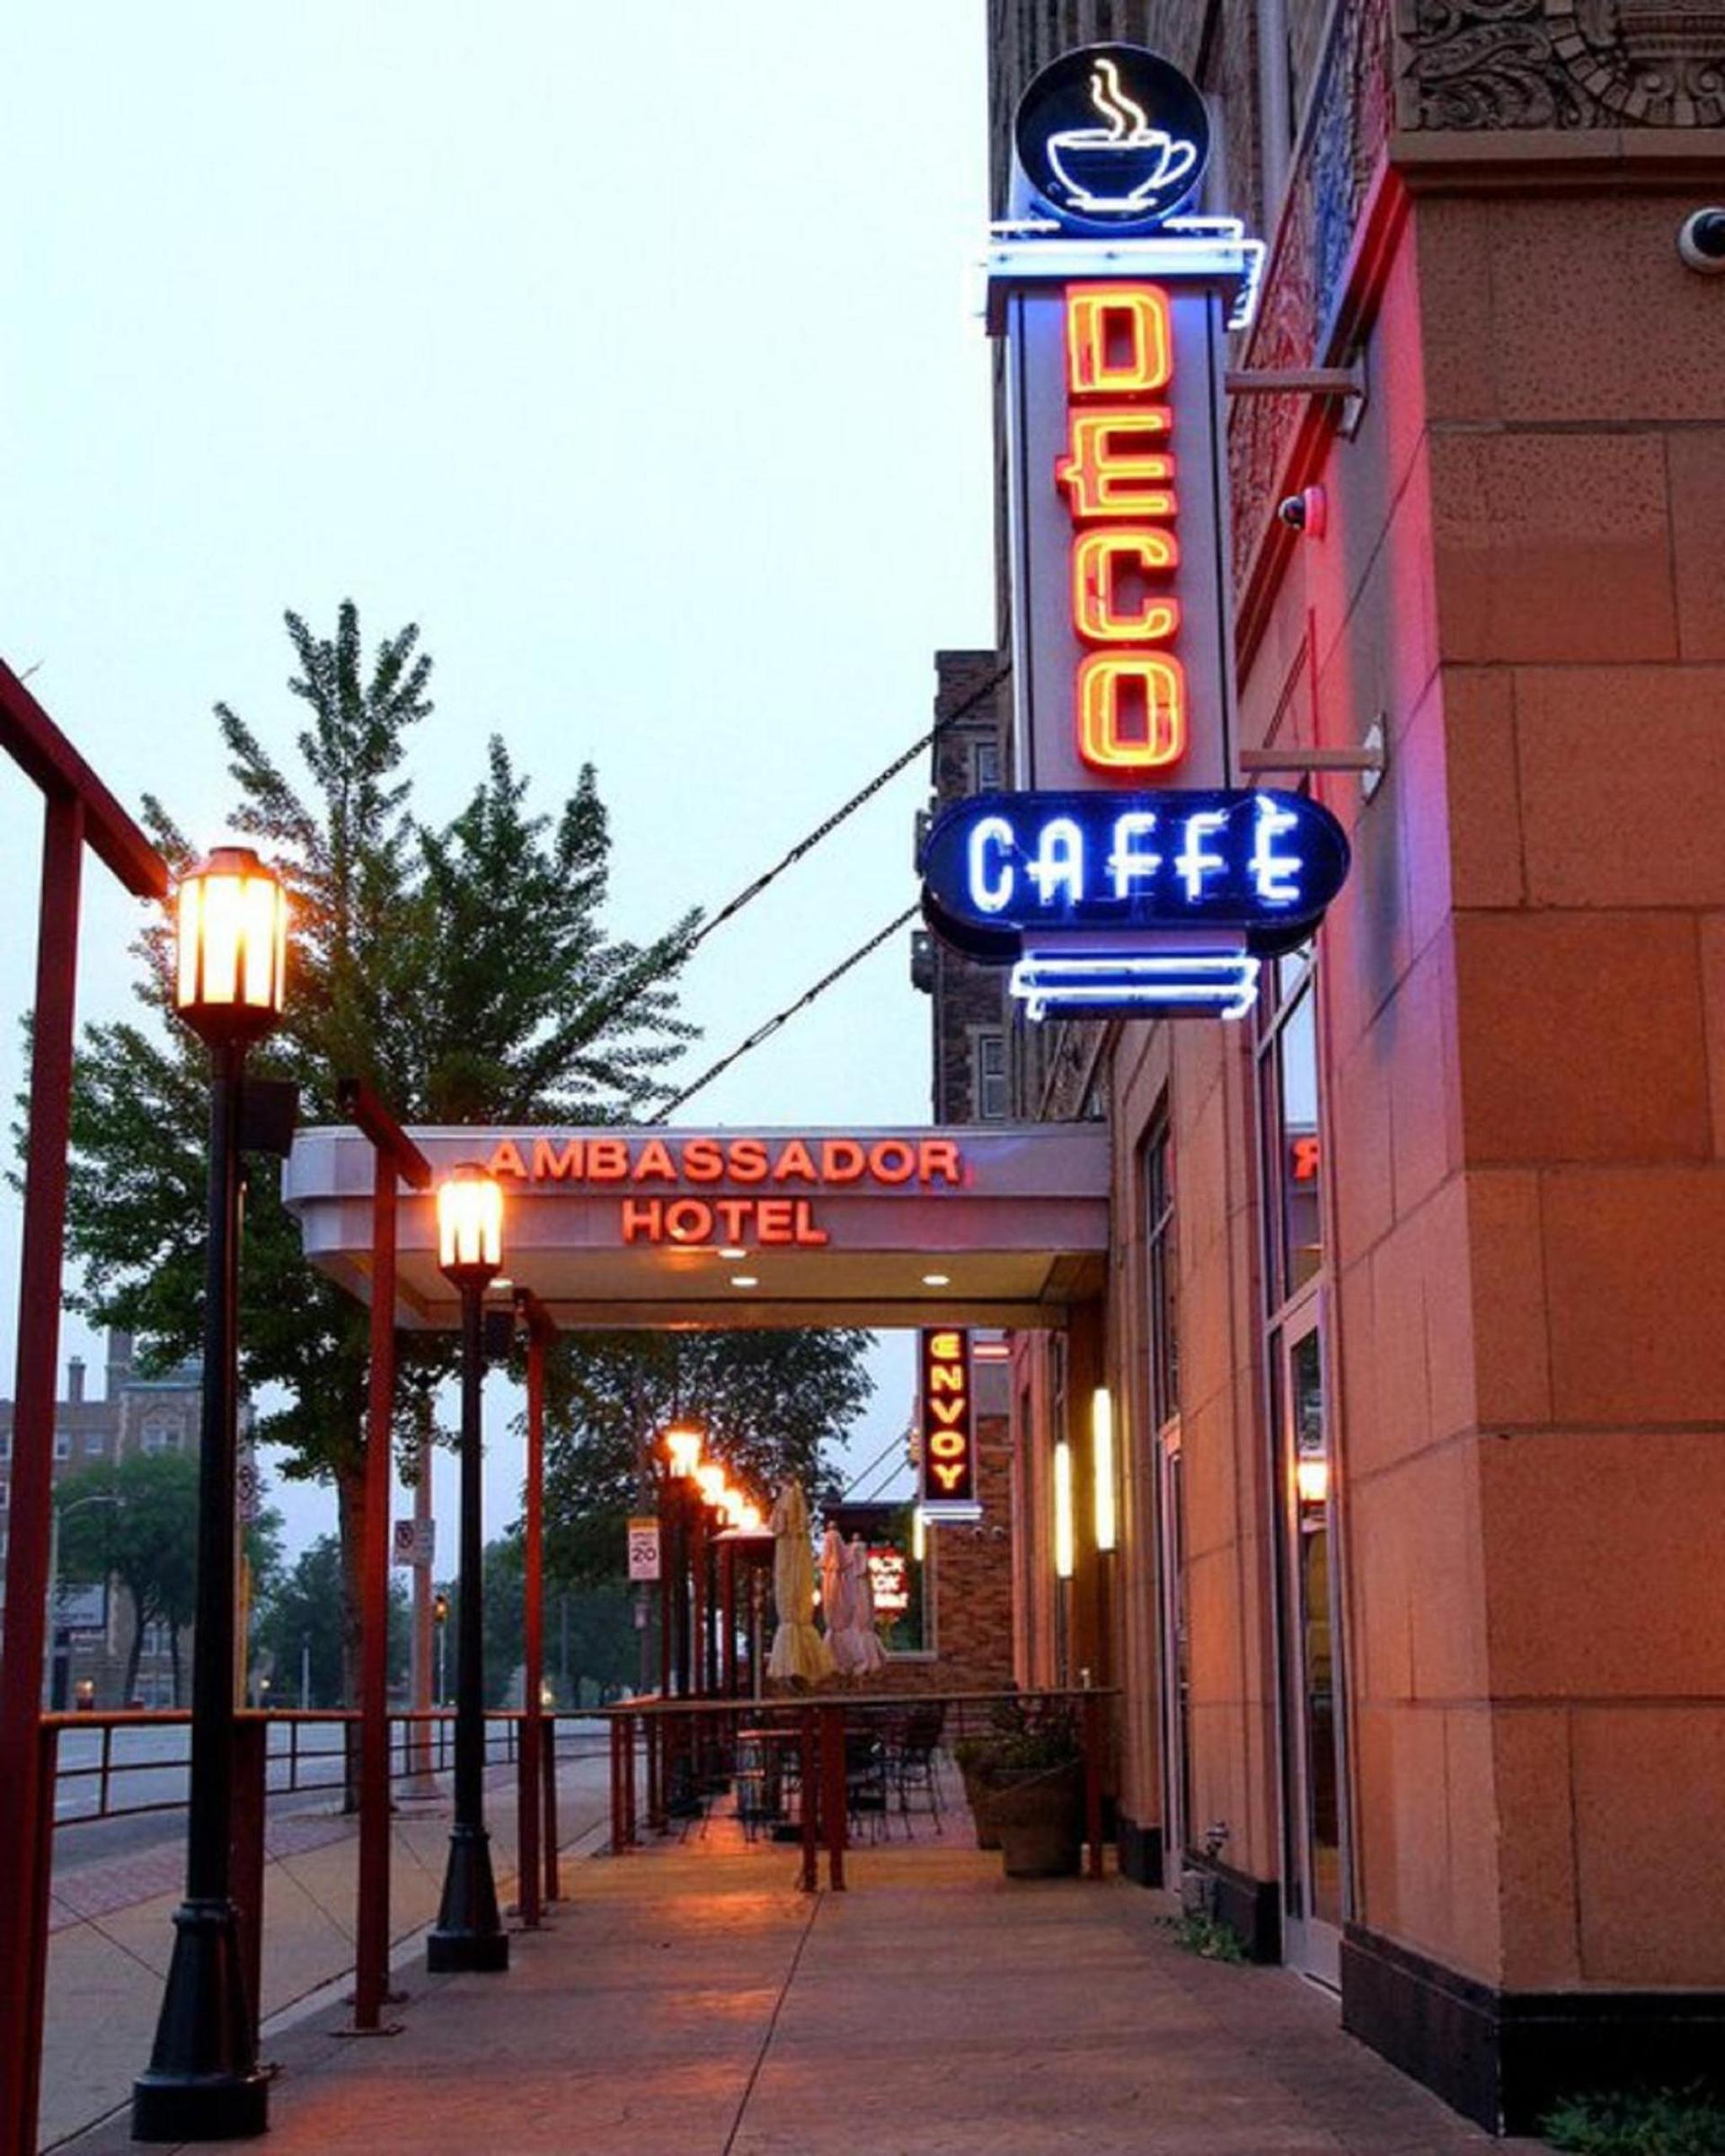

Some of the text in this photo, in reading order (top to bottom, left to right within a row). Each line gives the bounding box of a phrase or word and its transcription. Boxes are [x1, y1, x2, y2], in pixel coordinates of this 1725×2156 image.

[1055, 281, 1187, 775] DECO
[486, 1138, 960, 1185] AMBASSADOR
[621, 1199, 828, 1246] HOTEL
[929, 1332, 967, 1491] ENVOY
[632, 1546, 657, 1563] 20
